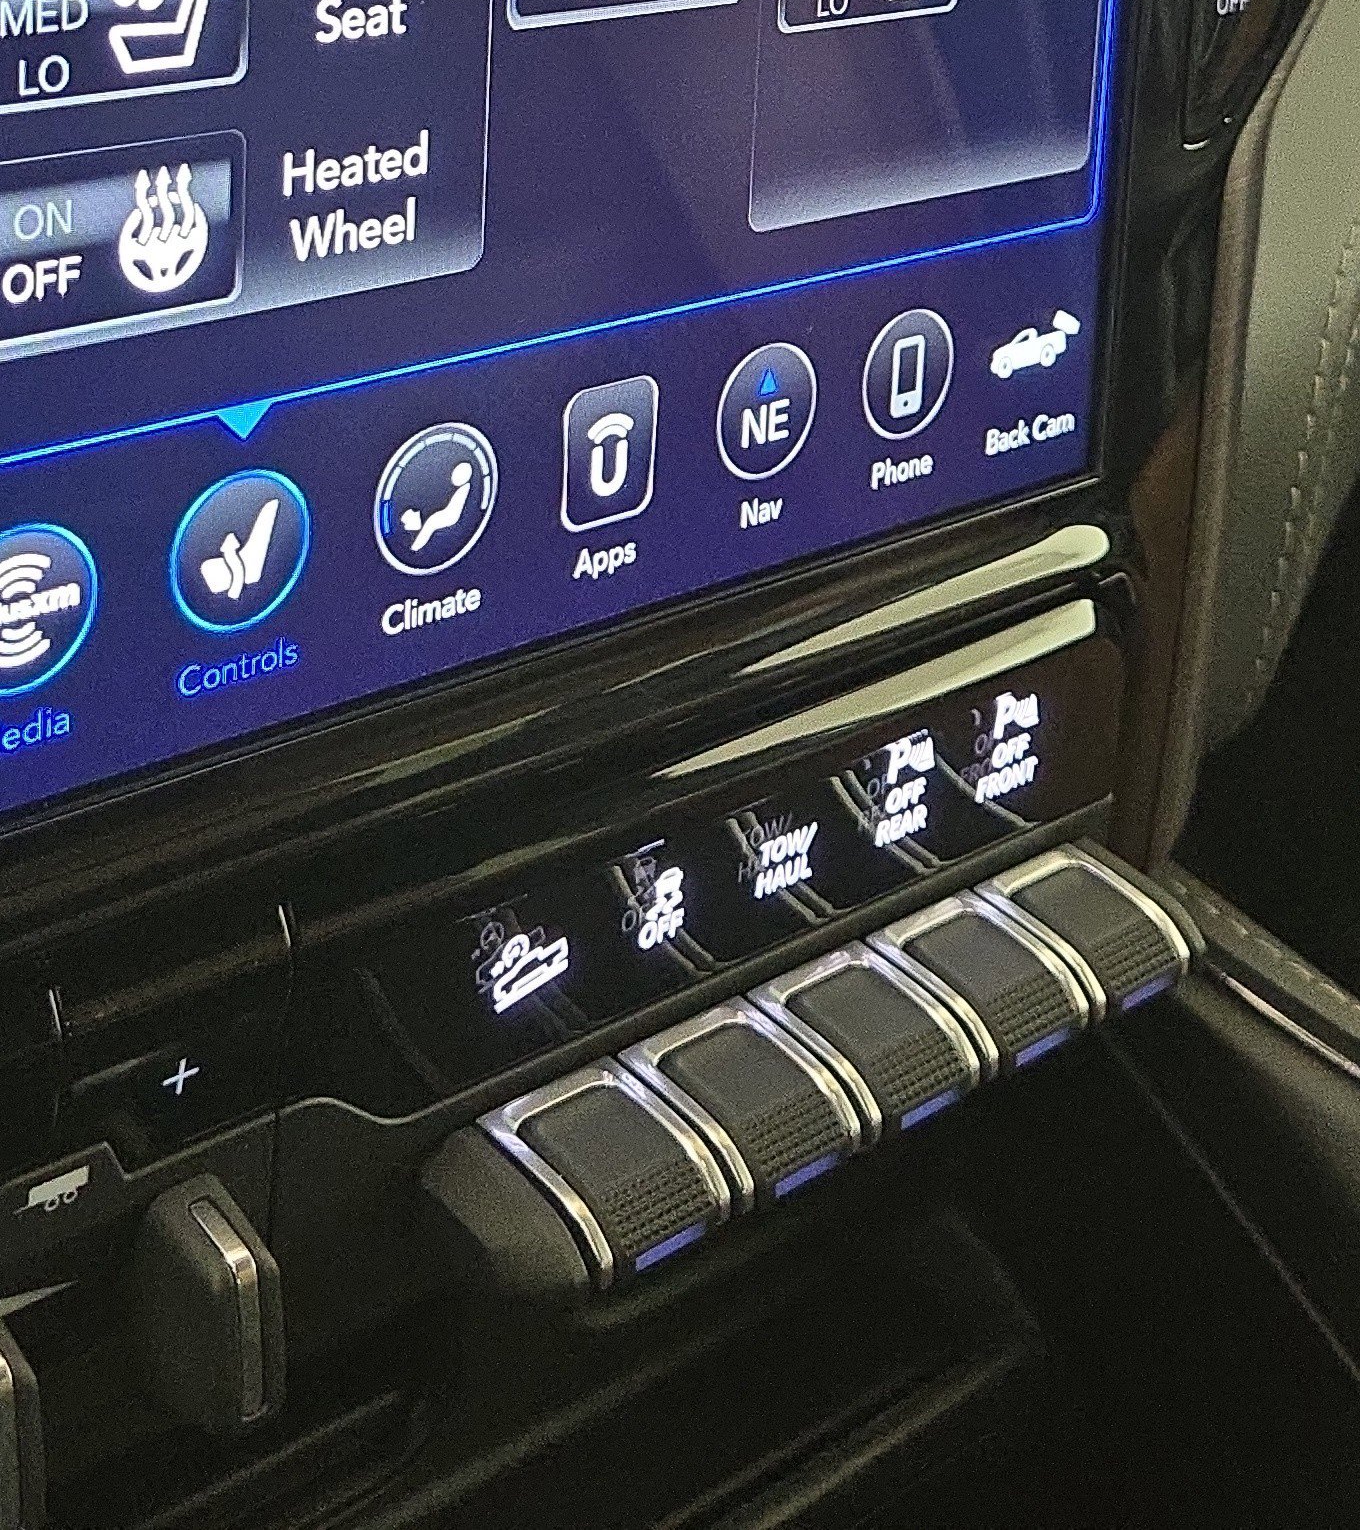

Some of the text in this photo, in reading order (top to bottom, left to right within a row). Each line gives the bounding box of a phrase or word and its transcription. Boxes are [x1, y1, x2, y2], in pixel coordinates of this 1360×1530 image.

[17, 56, 72, 98] LO
[281, 129, 430, 198] Heated
[12, 199, 74, 241] ON
[289, 197, 418, 263] Wheel
[1, 255, 83, 306] OFF
[740, 398, 792, 450] NE
[984, 411, 1076, 457] Back Cam
[870, 452, 934, 490] Phone
[739, 496, 784, 530] Nav
[571, 541, 637, 581] Apps
[380, 585, 483, 637] Climate
[176, 636, 301, 697] Controls
[990, 732, 1031, 769] OFF
[884, 776, 927, 814] OFF
[974, 756, 1039, 804] FRONT
[874, 804, 929, 849] REAR
[753, 853, 814, 900] HAUL
[638, 908, 685, 951] OFF
